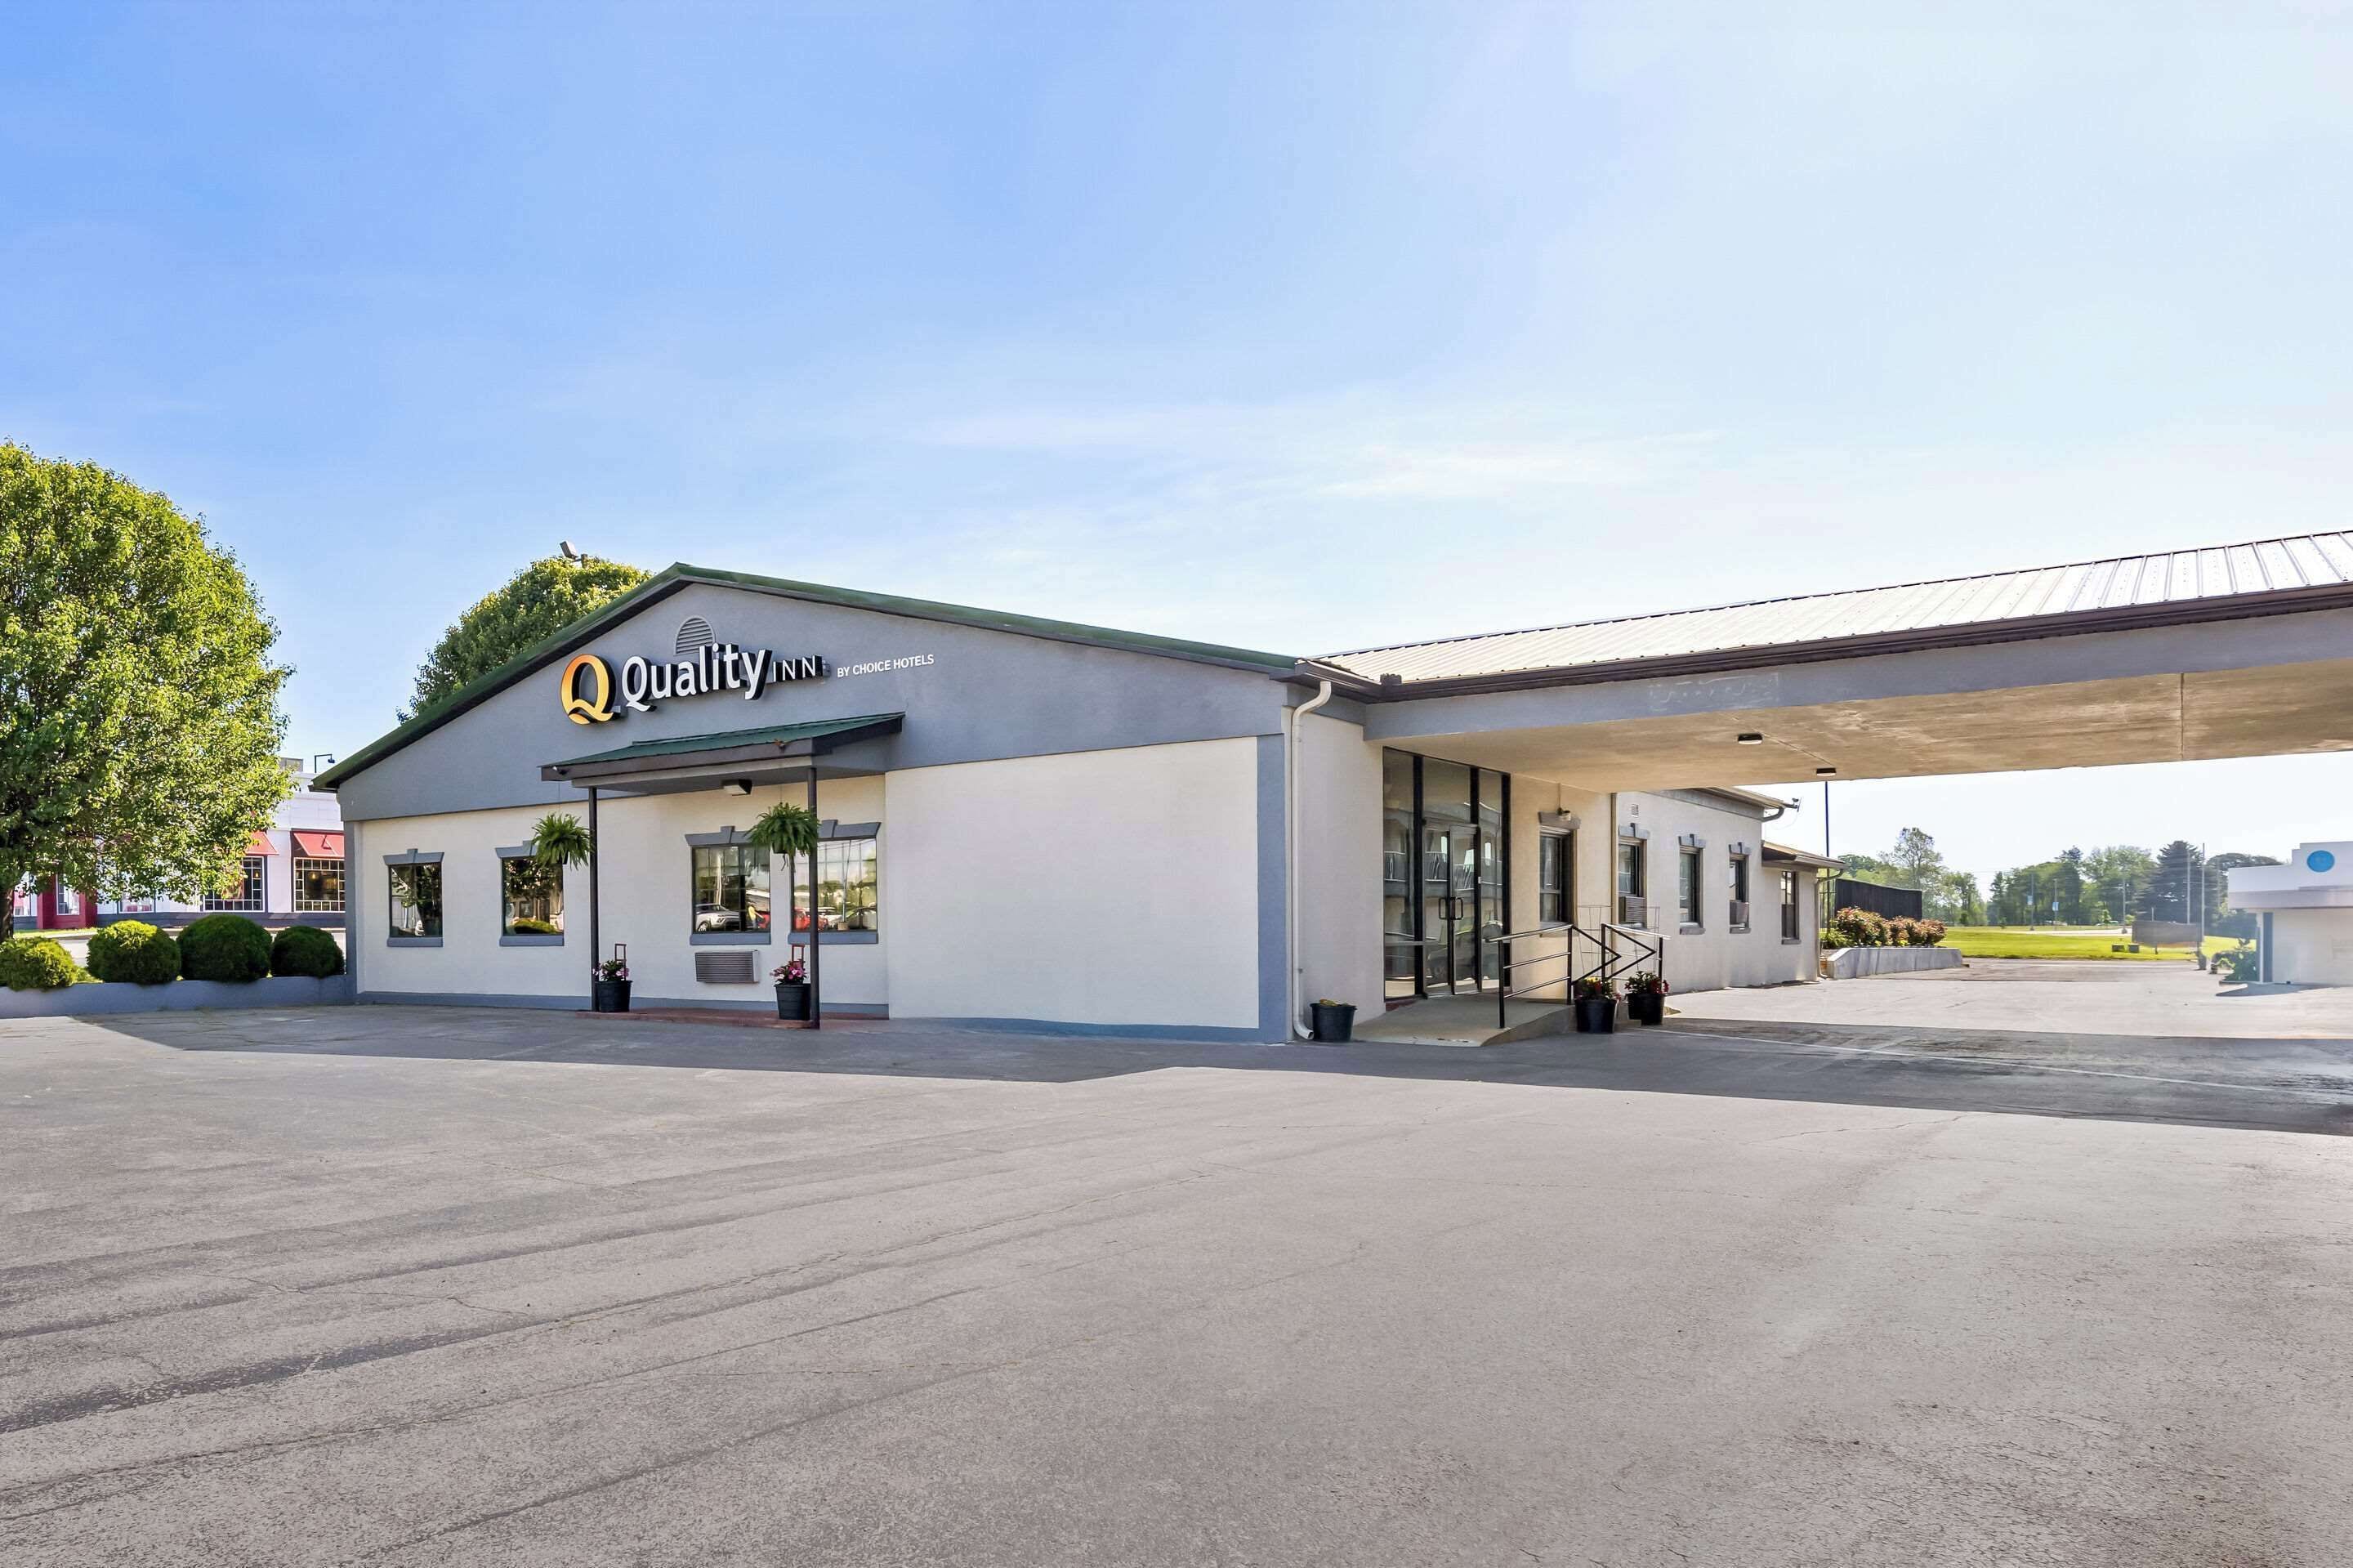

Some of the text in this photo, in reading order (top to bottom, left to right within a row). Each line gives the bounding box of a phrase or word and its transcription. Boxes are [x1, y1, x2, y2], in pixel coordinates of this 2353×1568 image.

[560, 643, 822, 726] Q Quality INN
[837, 654, 935, 678] BY CHOICE HOTELS
